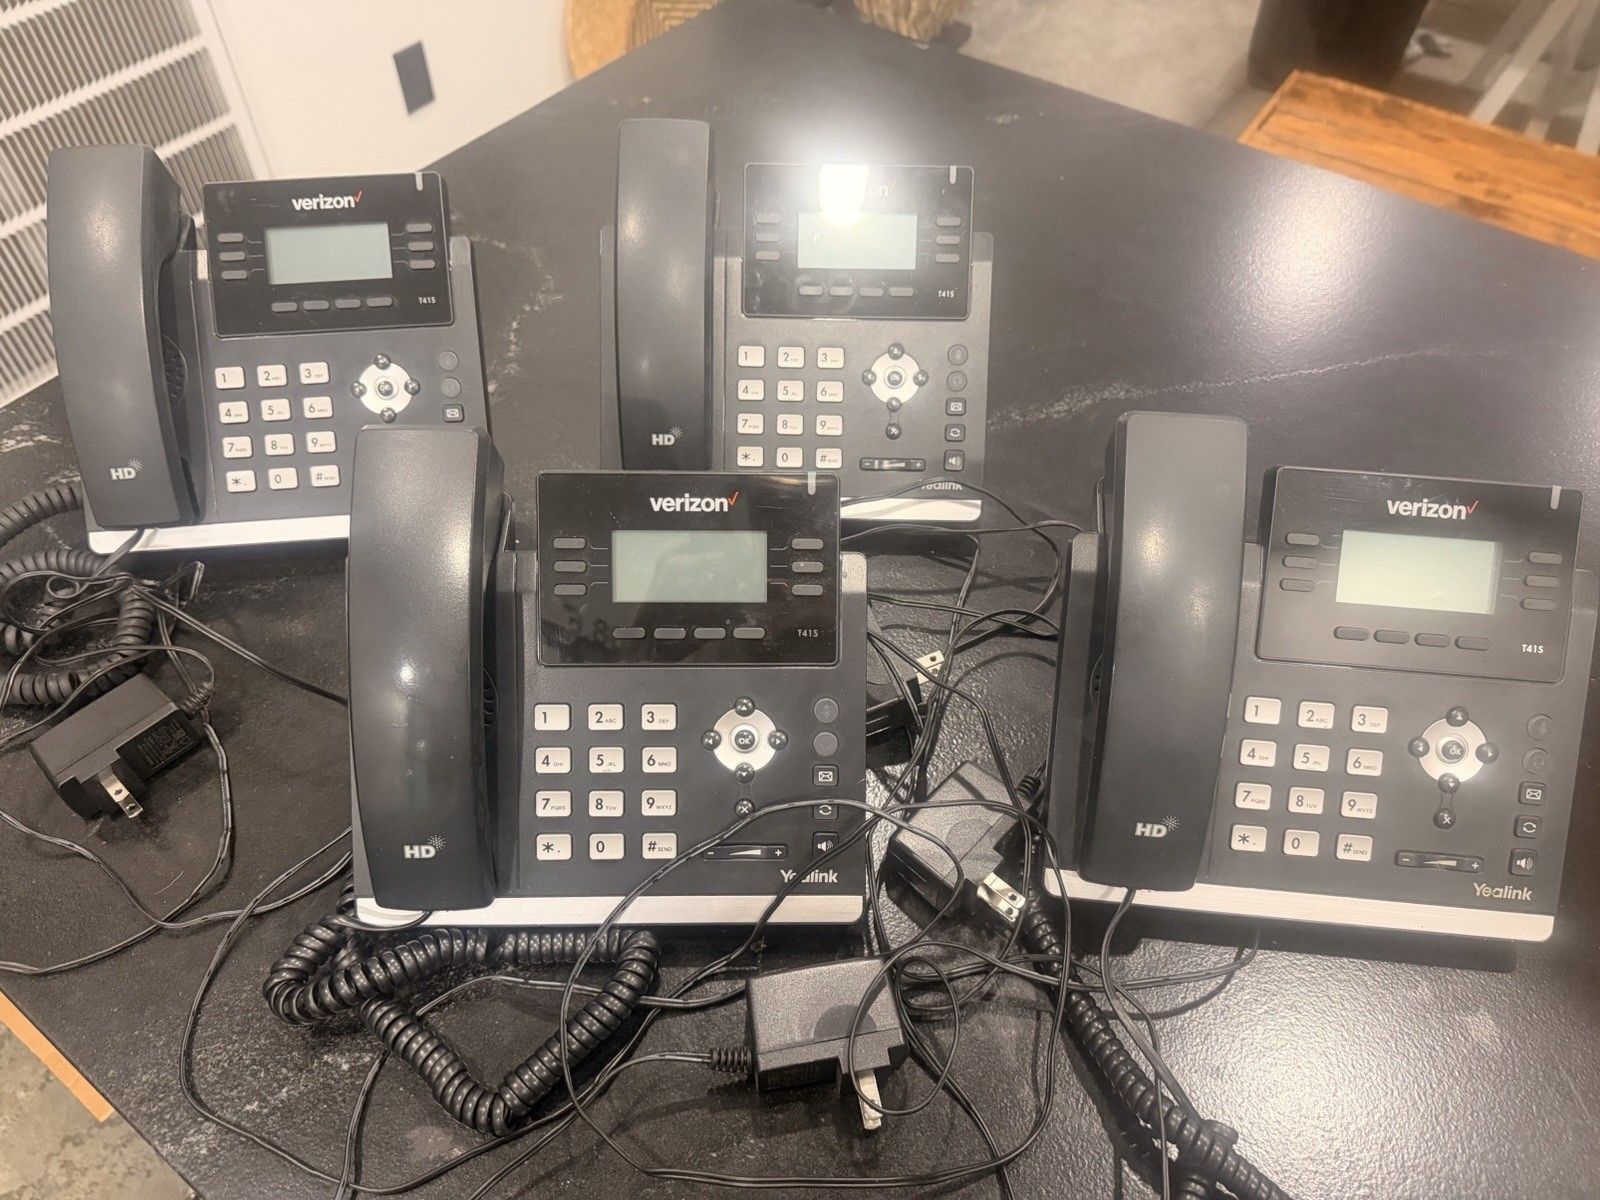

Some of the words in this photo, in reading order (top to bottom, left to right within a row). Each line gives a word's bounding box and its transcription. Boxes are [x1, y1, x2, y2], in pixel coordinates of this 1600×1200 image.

[292, 194, 356, 211] verizon
[938, 290, 955, 298] T41S
[783, 352, 790, 362] 2
[821, 353, 828, 362] 3
[263, 371, 271, 381] 2
[304, 368, 312, 379] 3
[742, 385, 749, 395] 4
[783, 386, 789, 395] 5
[821, 387, 827, 397] 6
[225, 408, 232, 418] 4
[268, 405, 275, 416] 5
[309, 403, 316, 413] 6
[742, 419, 748, 428] 7
[782, 420, 788, 429] 8
[820, 420, 827, 430] 9
[271, 440, 278, 450] 8
[311, 437, 319, 448] 9
[651, 433, 676, 446] HD
[228, 443, 235, 452] 7
[781, 453, 788, 462] 0
[110, 467, 137, 480] HD
[275, 474, 282, 484] 0
[922, 481, 963, 491] ealink
[650, 493, 729, 512] verizon
[1386, 498, 1467, 520] verizon
[797, 629, 819, 638] T41S
[1521, 643, 1544, 654] T41S
[1254, 705, 1259, 717] 1
[1306, 709, 1315, 722] 2
[542, 712, 547, 724] 1
[595, 711, 604, 724] 2
[646, 711, 655, 724] 3
[1358, 714, 1366, 726] 3
[738, 736, 751, 745] OK
[1247, 747, 1256, 760] 4
[1449, 747, 1462, 756] OK
[541, 755, 551, 767] 4
[596, 754, 604, 767] 5
[647, 754, 656, 767] 6
[1301, 752, 1310, 764] 5
[1353, 757, 1362, 769] 6
[1243, 790, 1252, 802] 7
[1296, 795, 1304, 808] 8
[542, 798, 551, 810] 7
[595, 798, 604, 810] 8
[646, 797, 655, 809] 9
[1348, 799, 1356, 811] 9
[1135, 822, 1168, 838] HD
[596, 841, 605, 853] 0
[1291, 837, 1300, 850] 0
[403, 844, 436, 859] HD
[1473, 882, 1533, 901] Yealink
